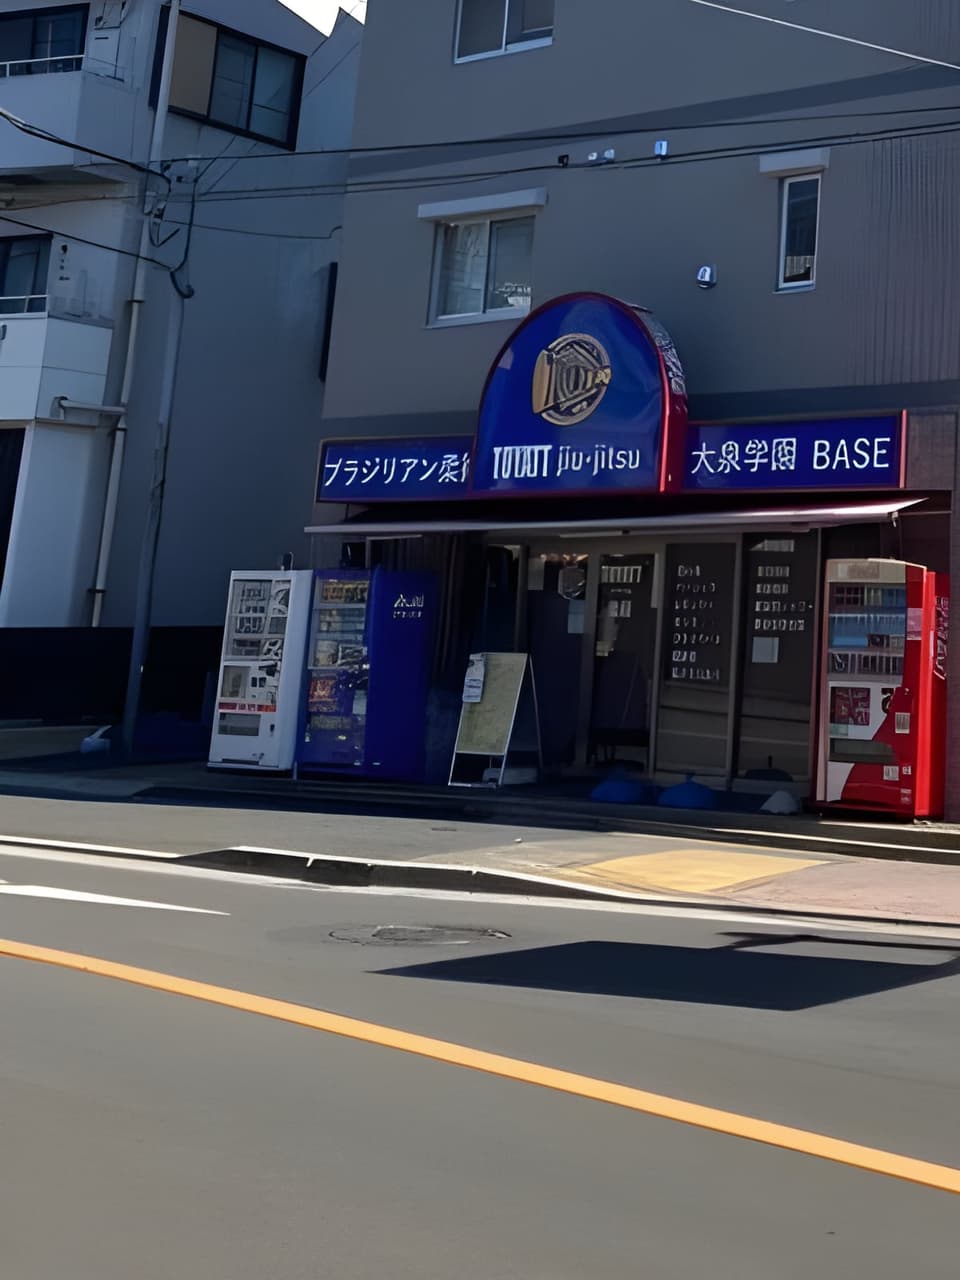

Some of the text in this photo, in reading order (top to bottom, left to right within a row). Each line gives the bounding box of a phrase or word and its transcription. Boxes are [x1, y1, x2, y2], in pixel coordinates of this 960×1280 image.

[691, 437, 891, 474] 大泉学園 BASE
